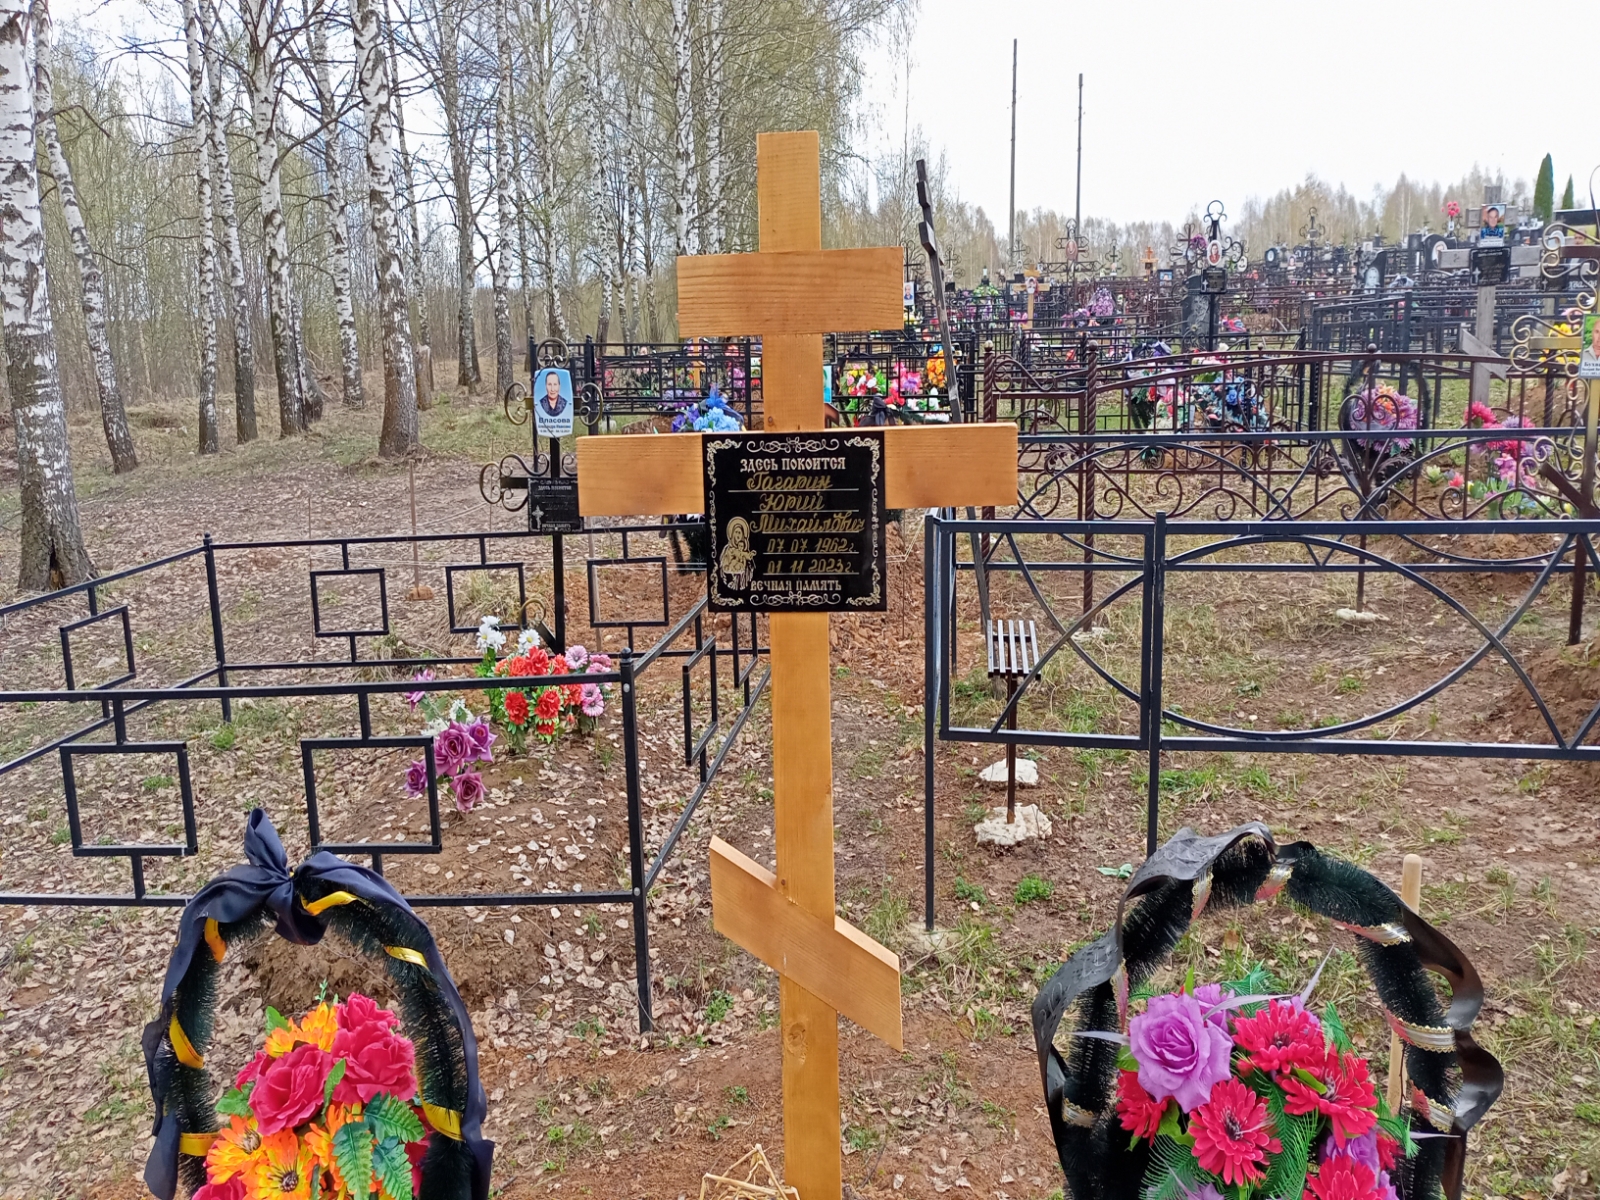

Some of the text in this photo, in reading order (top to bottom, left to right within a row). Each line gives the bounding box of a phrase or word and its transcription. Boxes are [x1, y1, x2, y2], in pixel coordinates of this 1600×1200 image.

[740, 457, 846, 473] ЗДЕСЬ ПОКОИТСЯ
[747, 471, 834, 491] Гагарин
[759, 491, 825, 512] Юрий
[750, 510, 866, 533] Михайлович
[750, 579, 842, 591] ВЕЧНАЯ ПАМЯТЬ
